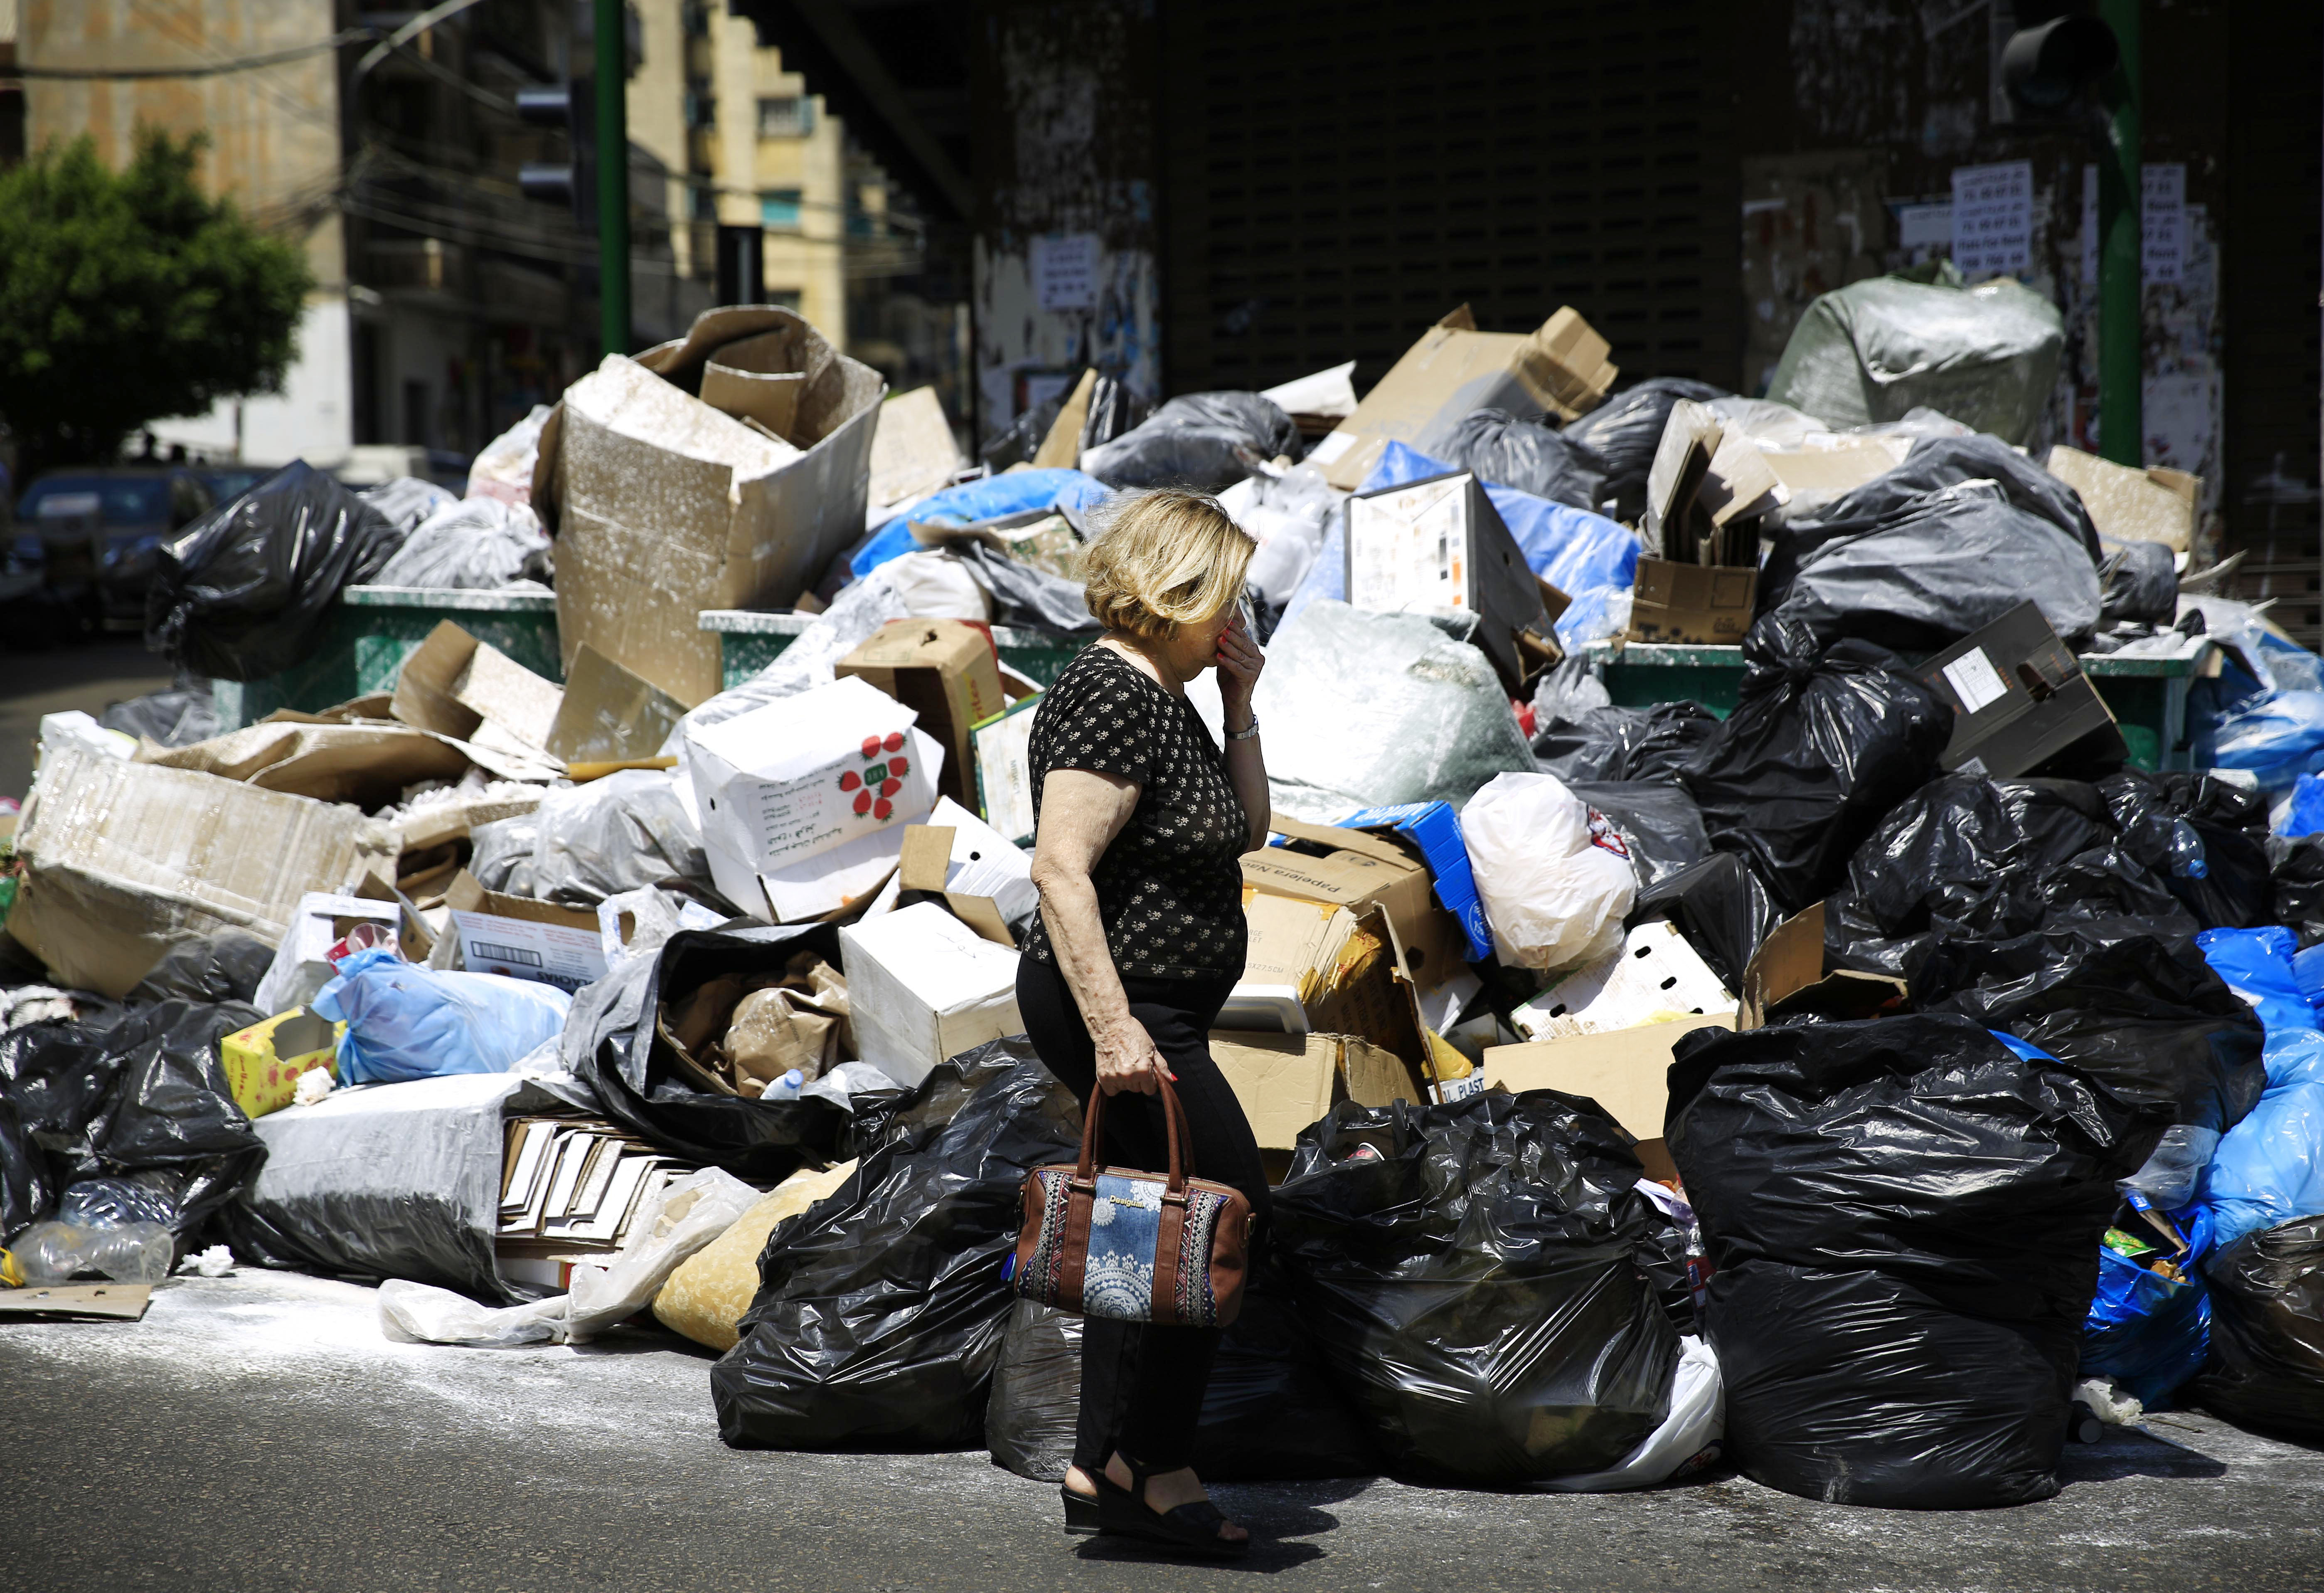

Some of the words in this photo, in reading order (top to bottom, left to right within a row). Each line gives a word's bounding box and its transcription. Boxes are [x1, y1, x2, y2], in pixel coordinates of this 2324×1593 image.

[1274, 870, 1341, 893] Papelera
[537, 971, 593, 987] LACHAS
[1458, 1077, 1484, 1100] PLAST
